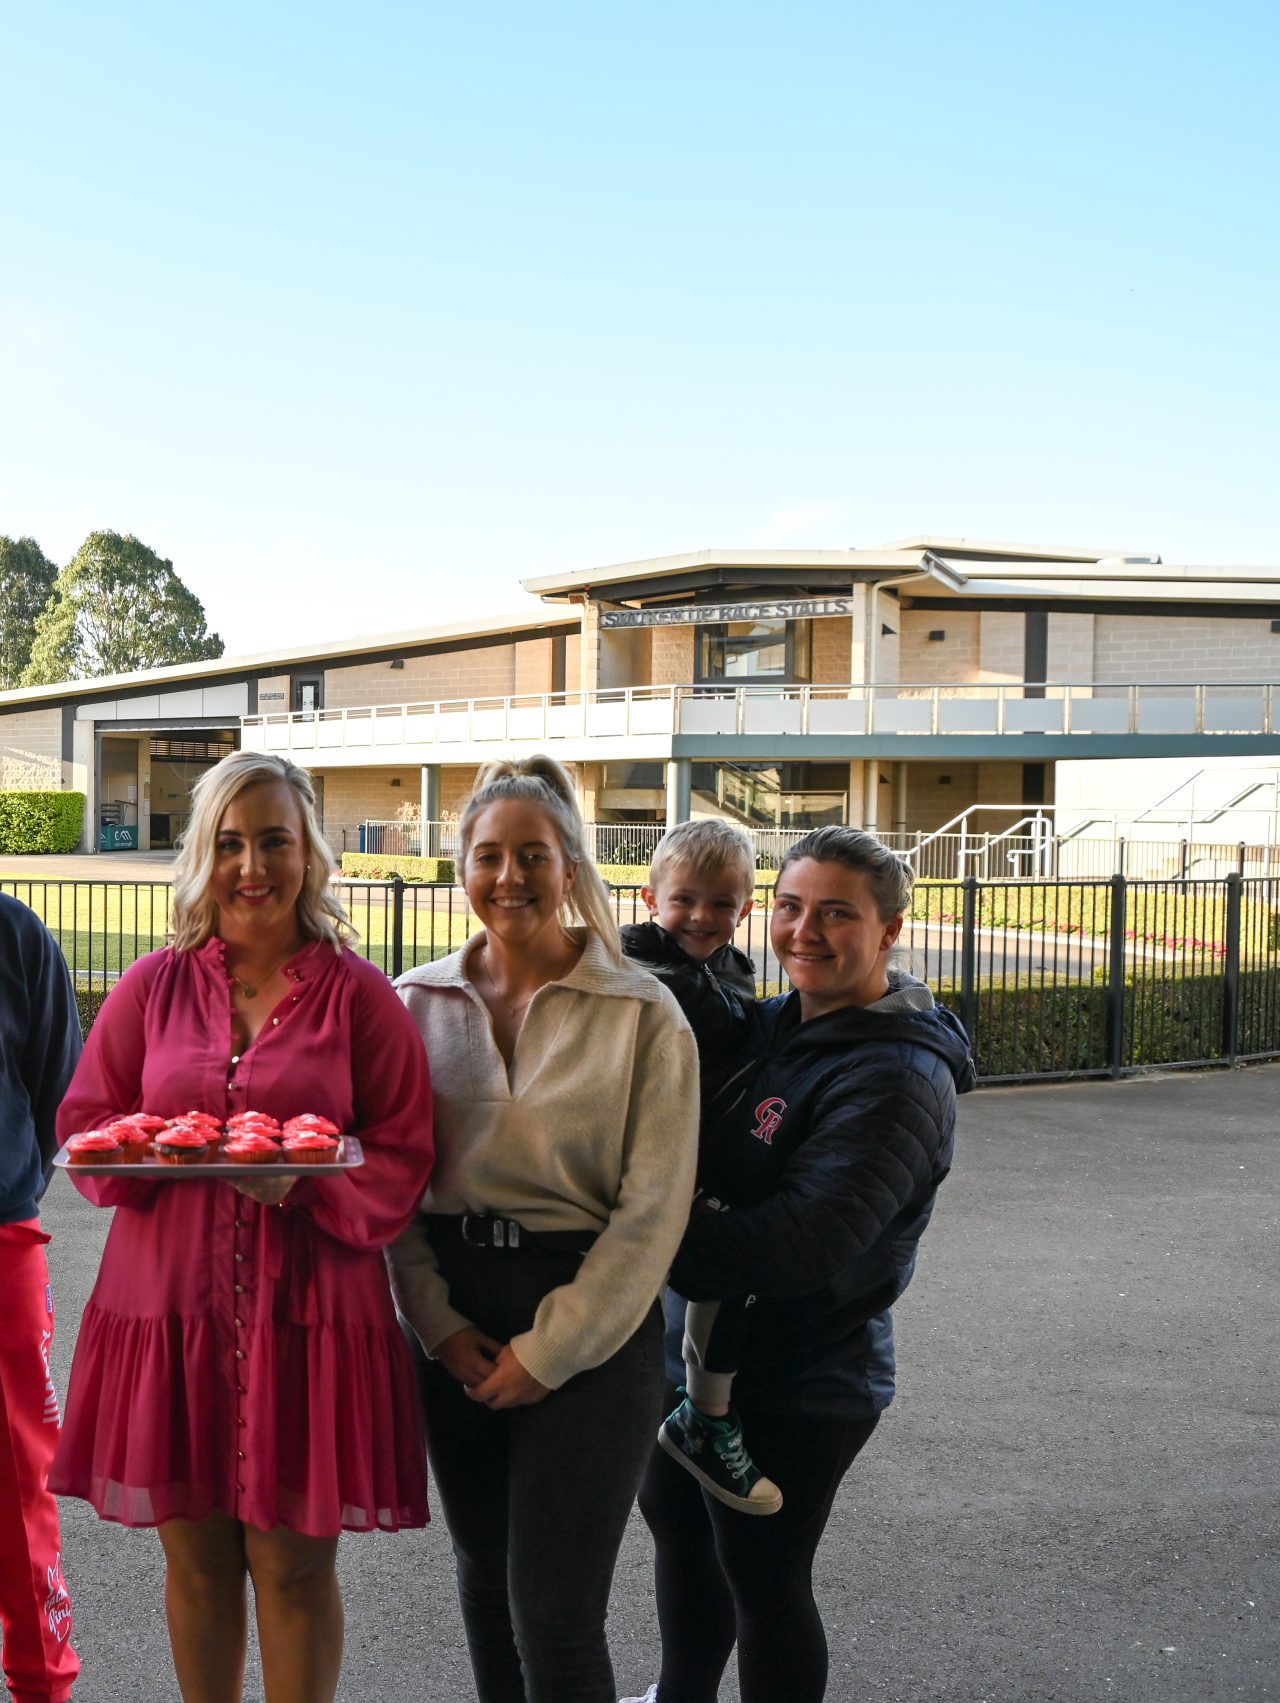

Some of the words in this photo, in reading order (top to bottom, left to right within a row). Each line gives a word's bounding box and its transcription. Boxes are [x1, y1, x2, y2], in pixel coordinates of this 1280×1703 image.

[689, 607, 712, 622] UP
[719, 603, 769, 620] RACE
[775, 600, 848, 617] STALLS
